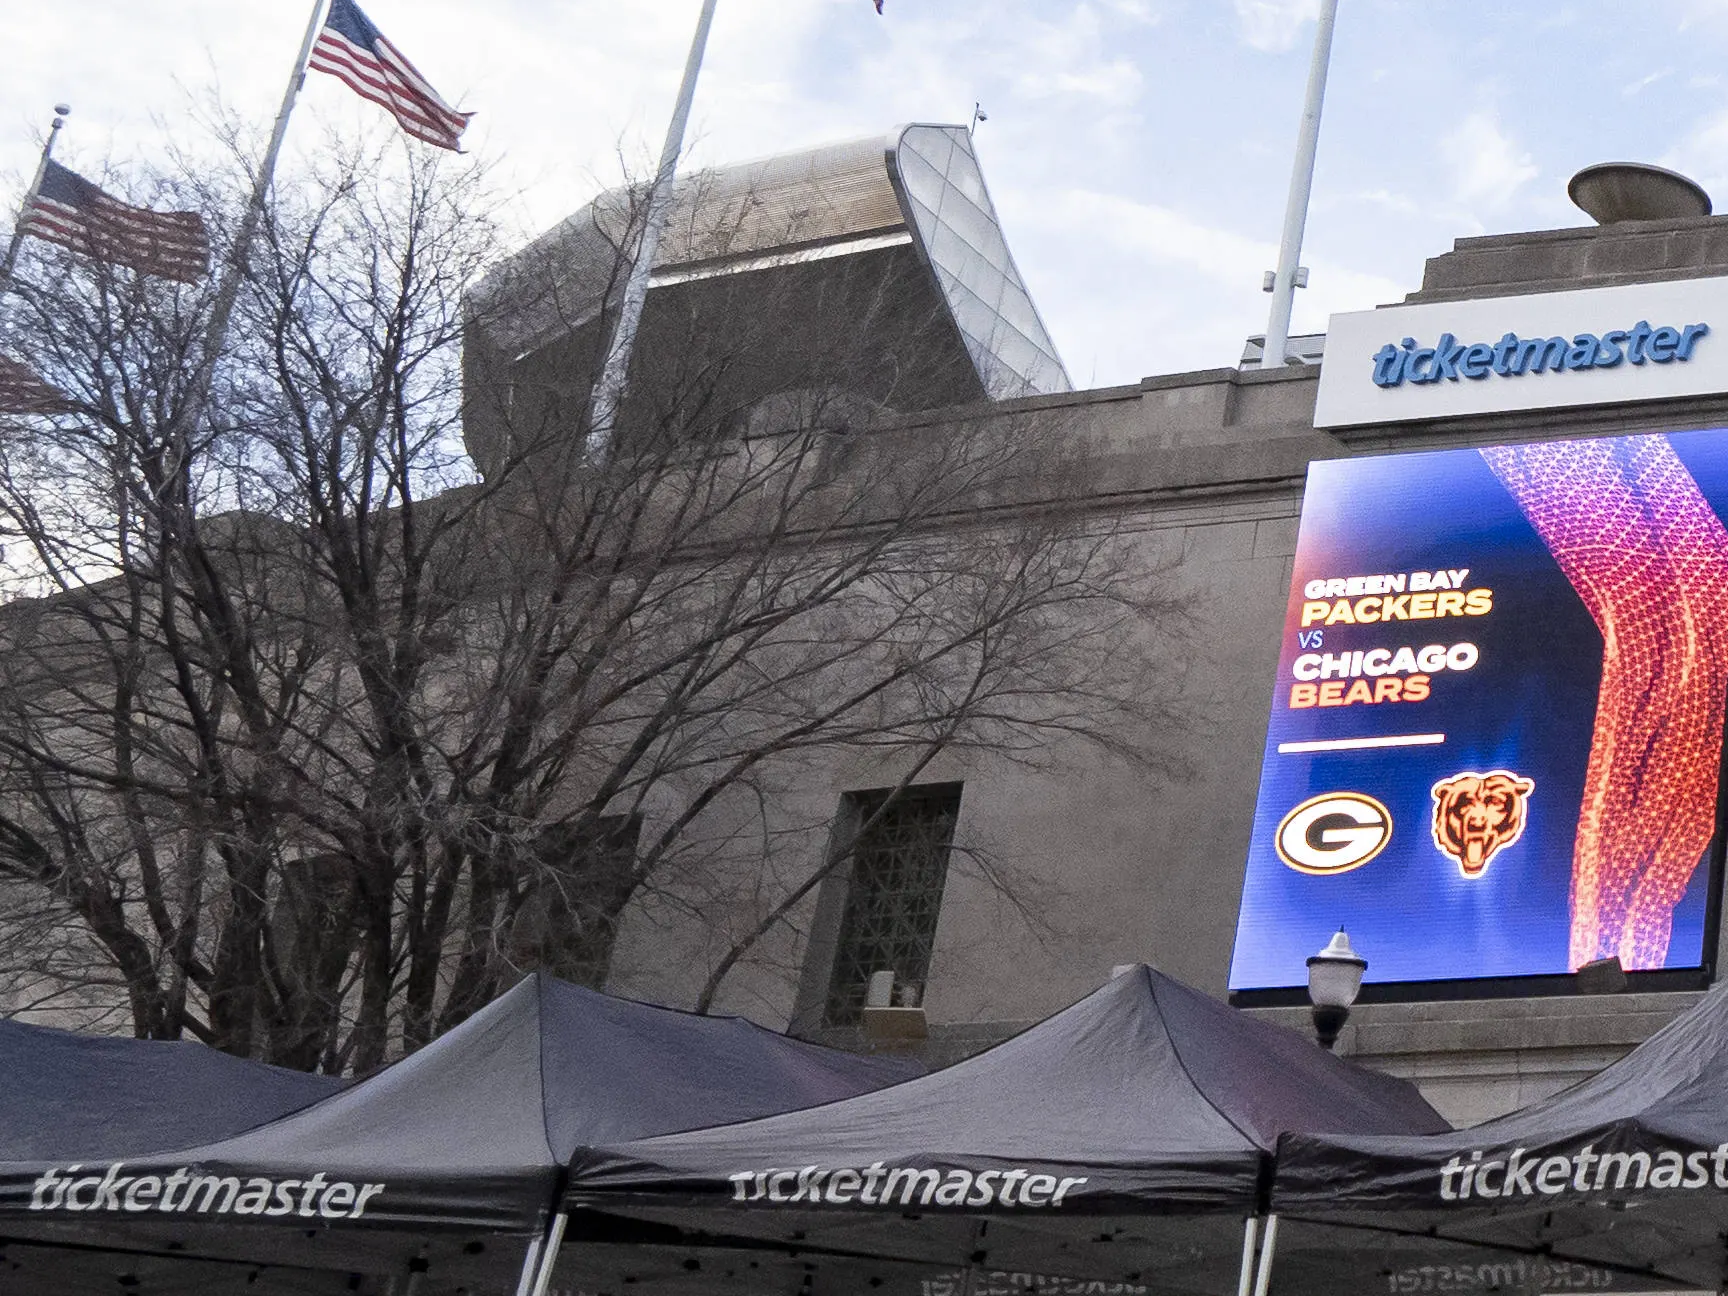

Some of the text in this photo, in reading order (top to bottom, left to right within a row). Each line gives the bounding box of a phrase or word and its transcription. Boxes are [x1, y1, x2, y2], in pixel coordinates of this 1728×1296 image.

[1371, 319, 1710, 388] ticketmaster
[1304, 569, 1470, 600] GREEN BAY
[1300, 589, 1492, 628] PACKERS
[1297, 630, 1324, 650] VS
[1292, 644, 1480, 681] CHICAGO
[1289, 676, 1431, 710] BEARS
[1280, 796, 1386, 869] G
[30, 1161, 385, 1218] ticketmaster
